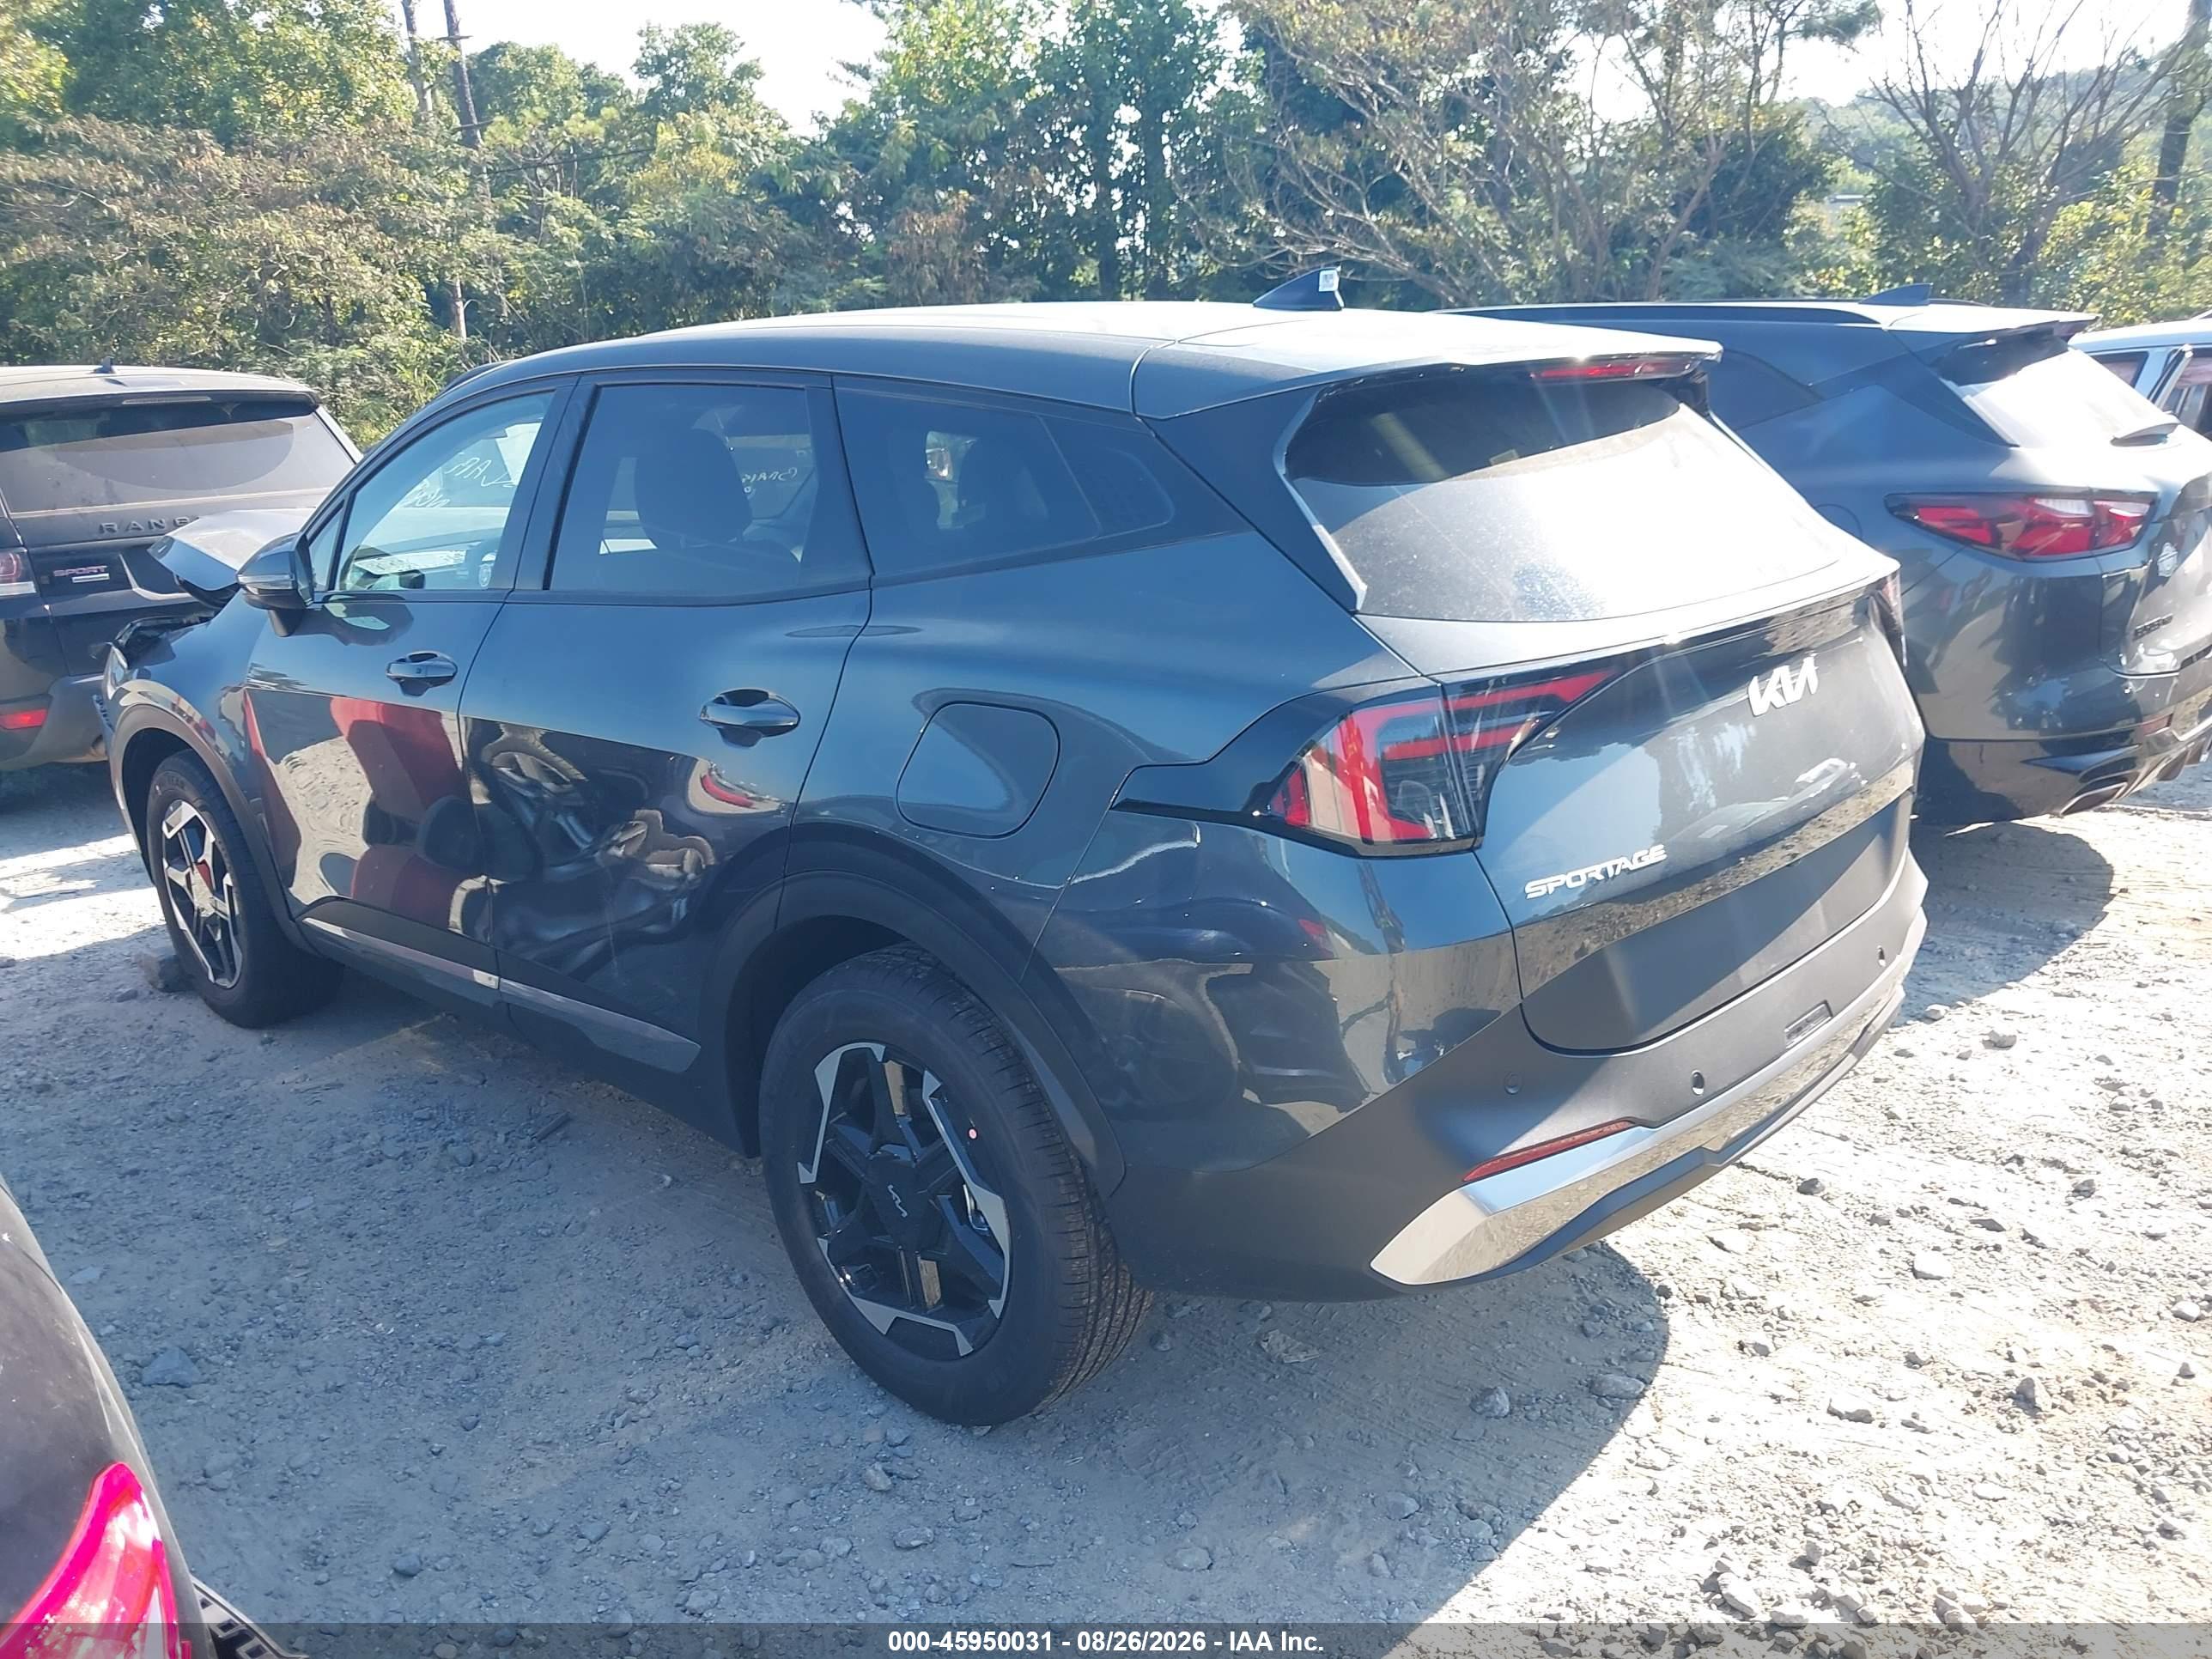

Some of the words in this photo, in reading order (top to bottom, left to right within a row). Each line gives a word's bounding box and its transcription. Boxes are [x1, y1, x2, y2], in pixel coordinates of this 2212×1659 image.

[53, 565, 107, 577] SPORT
[1747, 655, 1819, 717] KIA
[1524, 844, 1668, 900] SPORTAGE
